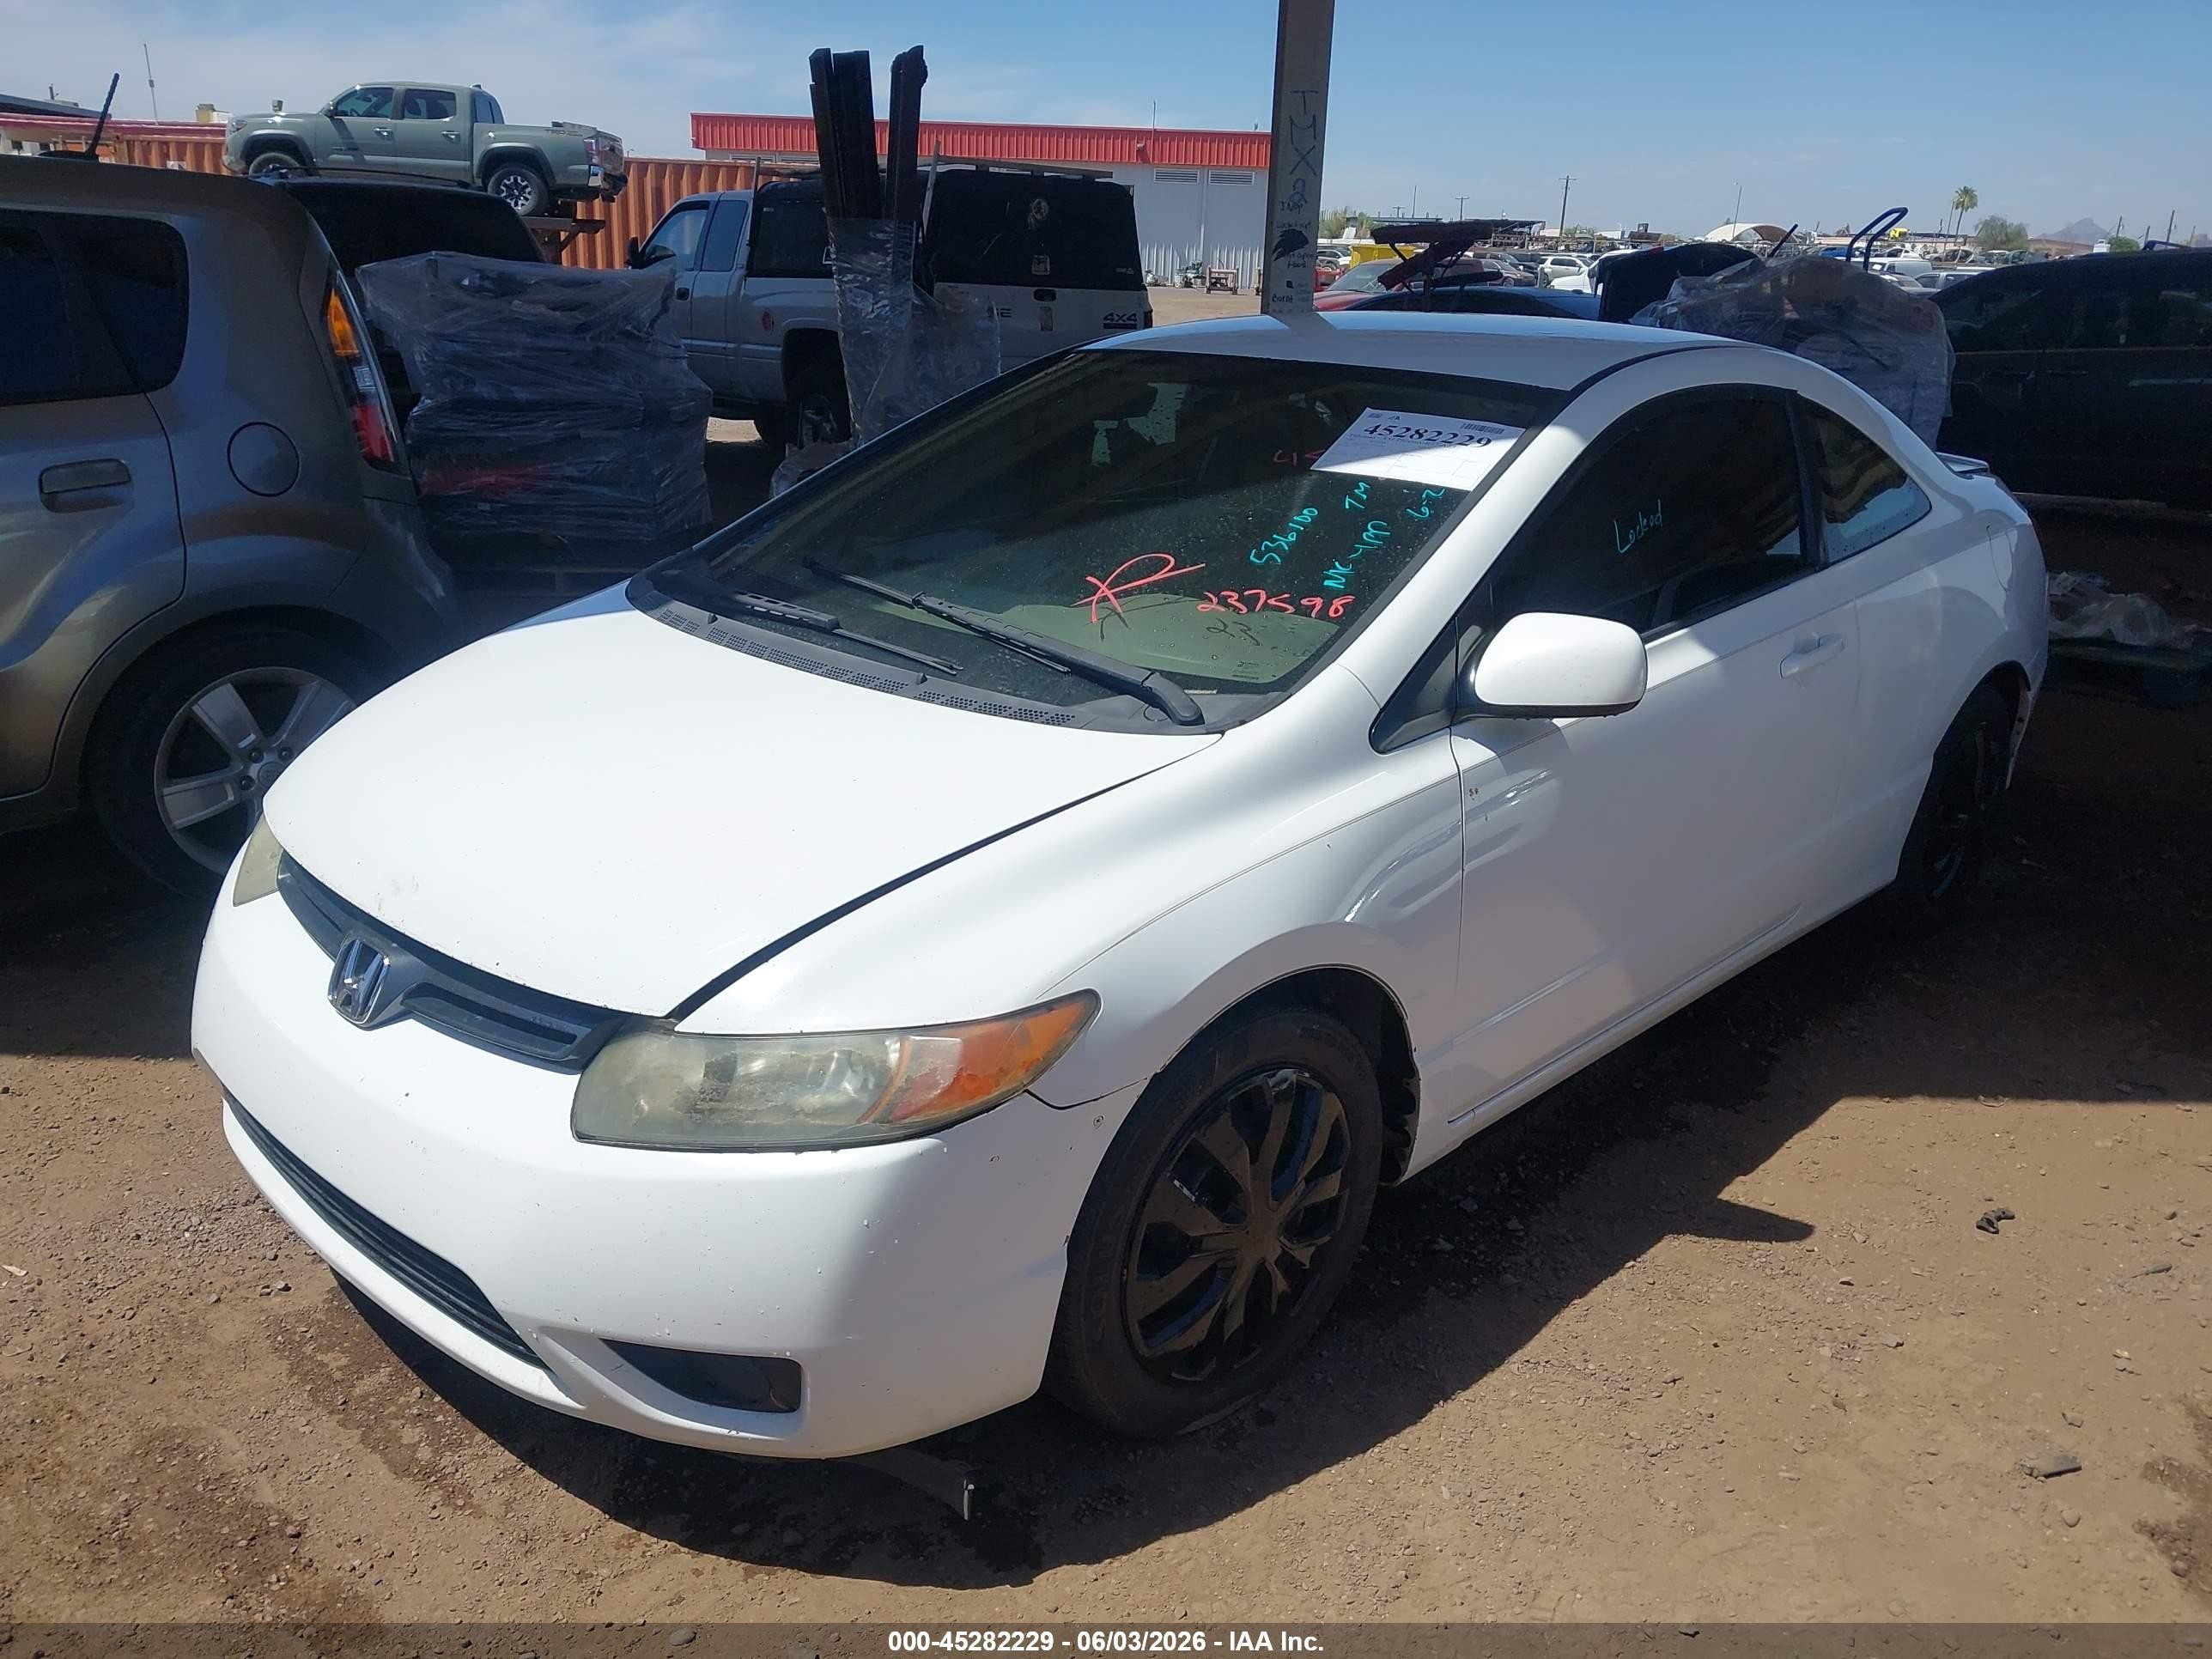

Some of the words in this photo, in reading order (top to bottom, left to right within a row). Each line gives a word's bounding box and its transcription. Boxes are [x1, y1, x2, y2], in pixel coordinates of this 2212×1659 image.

[1364, 423, 1492, 448] 45282229
[1249, 507, 1319, 565] 536100
[1196, 588, 1356, 619] 237598
